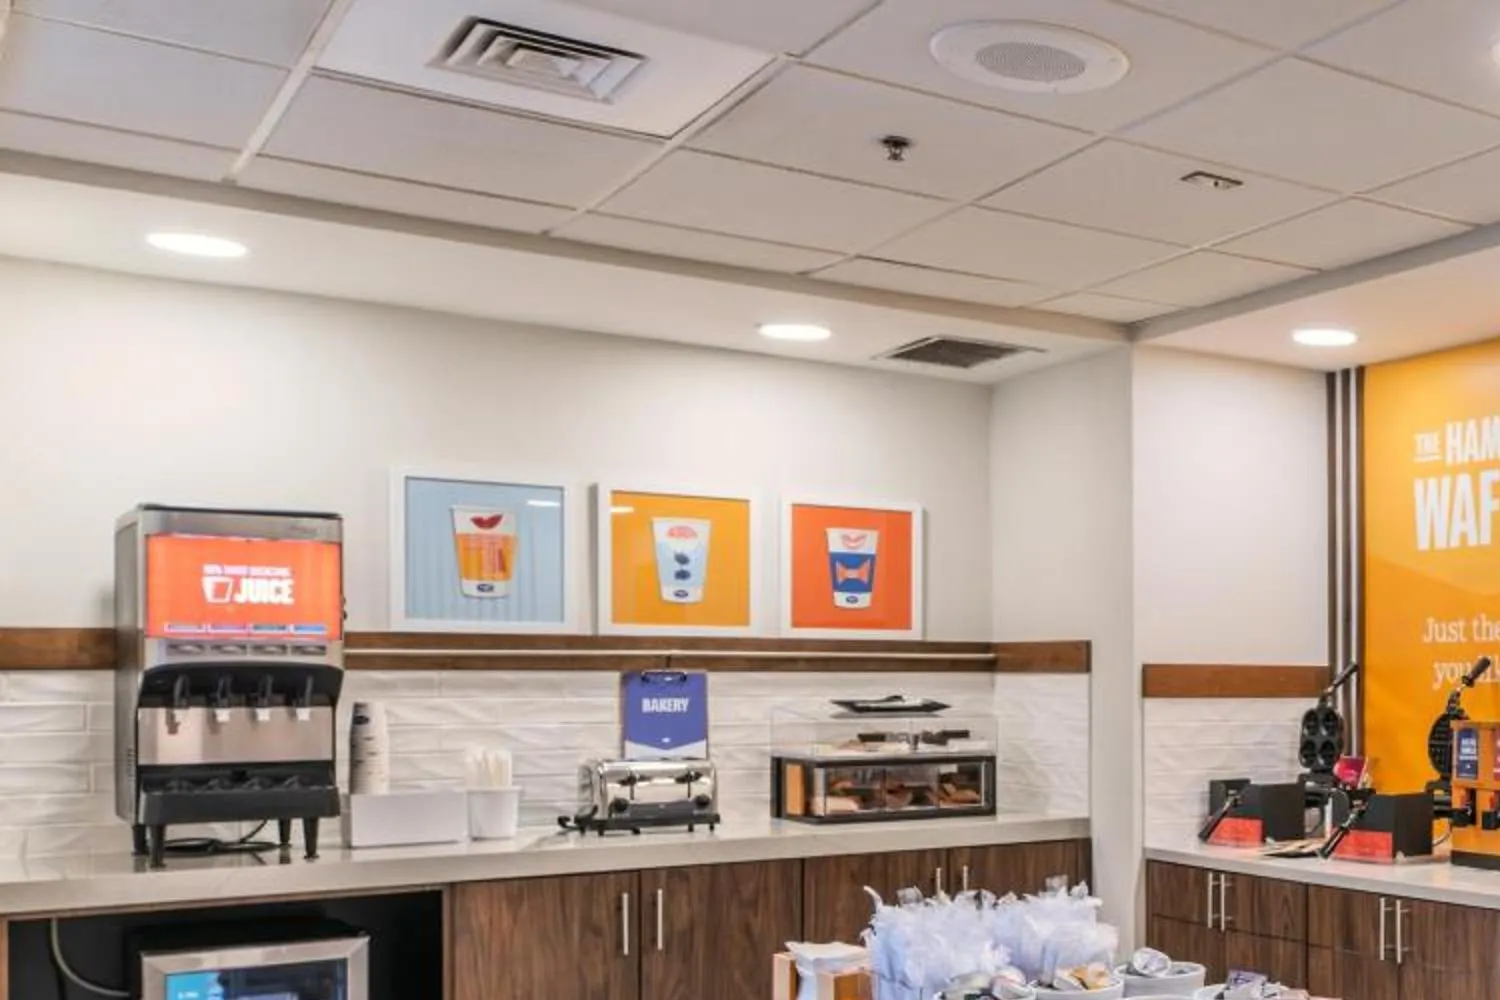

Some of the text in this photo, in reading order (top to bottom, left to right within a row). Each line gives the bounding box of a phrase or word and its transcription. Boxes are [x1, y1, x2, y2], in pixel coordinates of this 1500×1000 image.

[234, 577, 294, 605] JUICE
[1423, 616, 1466, 643] Just
[642, 696, 690, 713] BAKERY
